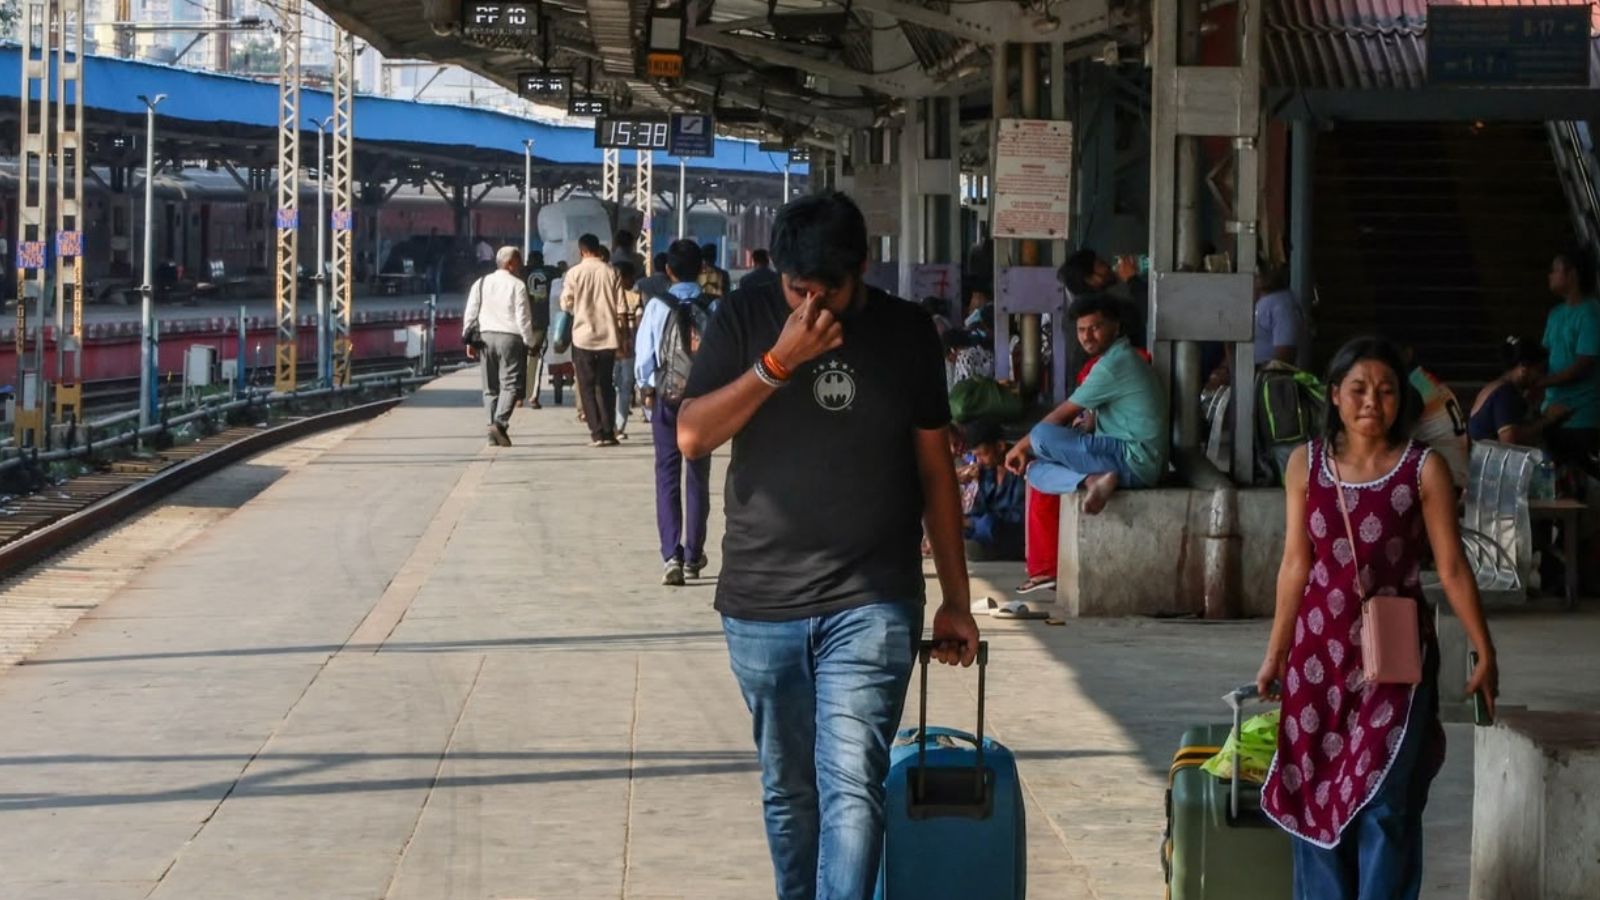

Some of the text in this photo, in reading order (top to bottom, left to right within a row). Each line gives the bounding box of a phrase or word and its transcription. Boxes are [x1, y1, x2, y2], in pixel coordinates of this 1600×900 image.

[475, 6, 526, 25] PF 10
[609, 121, 668, 147] 15:38
